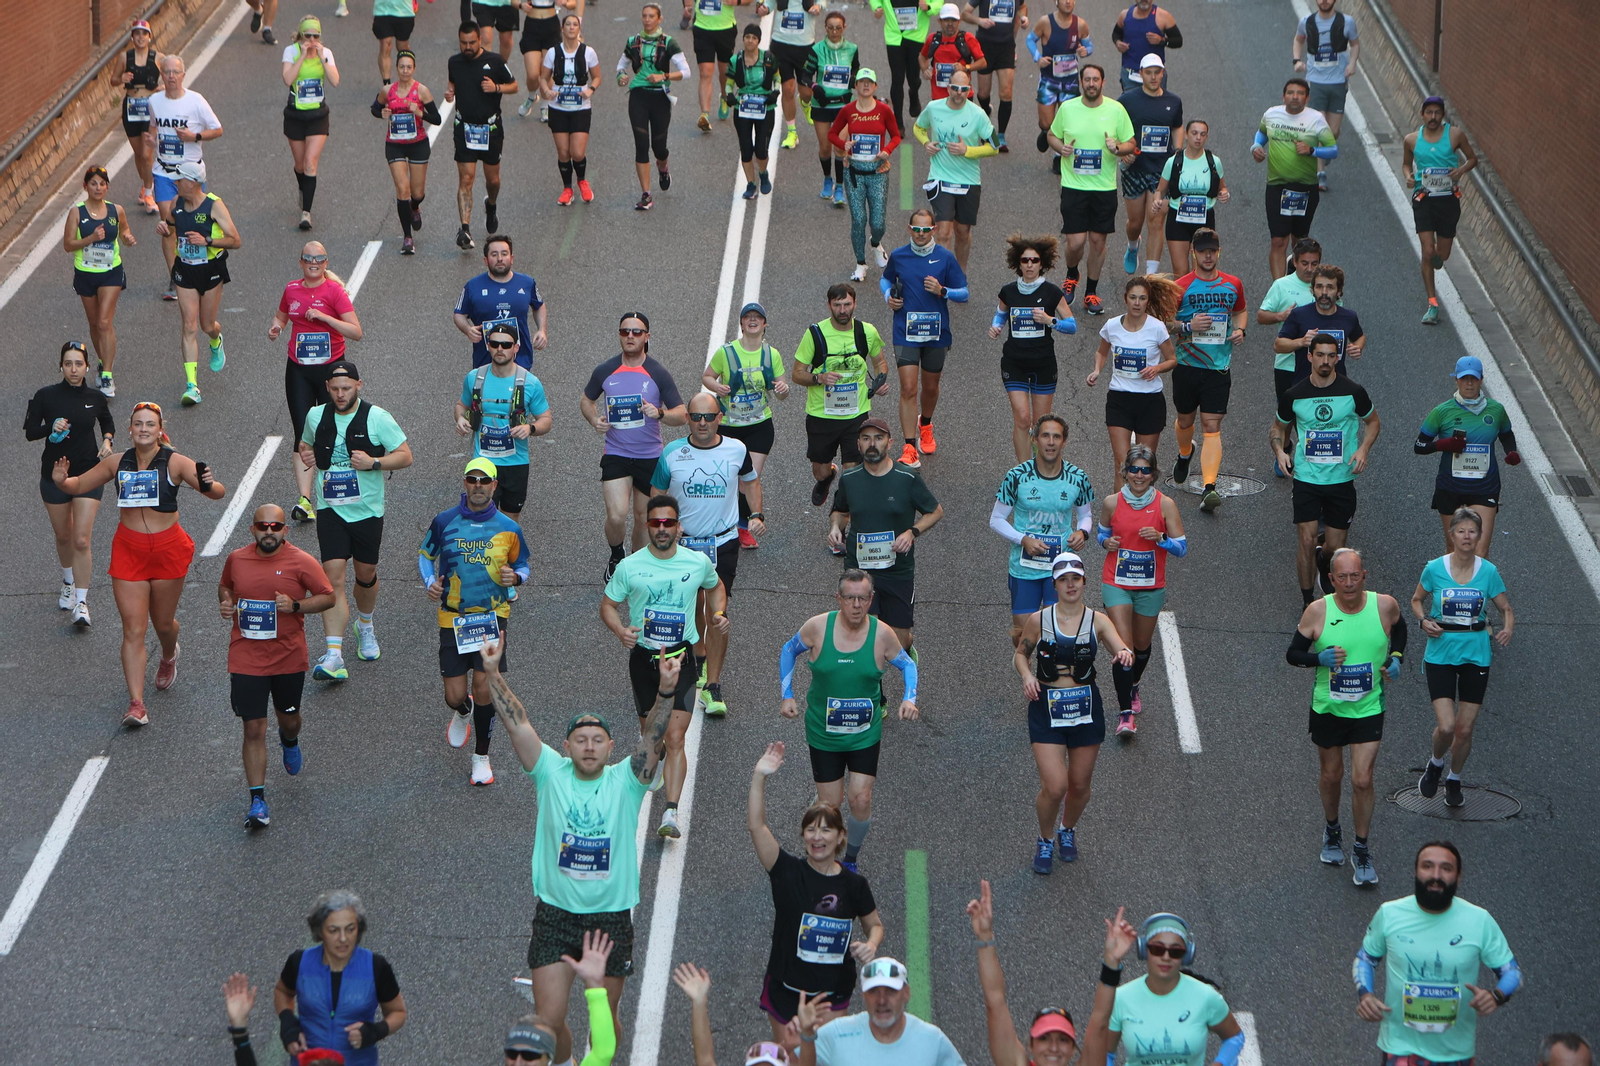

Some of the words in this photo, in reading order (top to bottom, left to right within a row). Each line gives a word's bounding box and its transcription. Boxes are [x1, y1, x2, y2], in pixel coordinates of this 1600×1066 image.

[154, 118, 188, 129] MARK
[184, 245, 200, 255] 568
[1188, 293, 1234, 306] BROOKS
[134, 472, 153, 480] ZURICH
[468, 613, 492, 623] ZURICH
[1063, 690, 1086, 698] ZURICH
[576, 840, 605, 848] ZURICH
[820, 920, 848, 930] ZURICH
[1422, 987, 1454, 996] ZURICH
